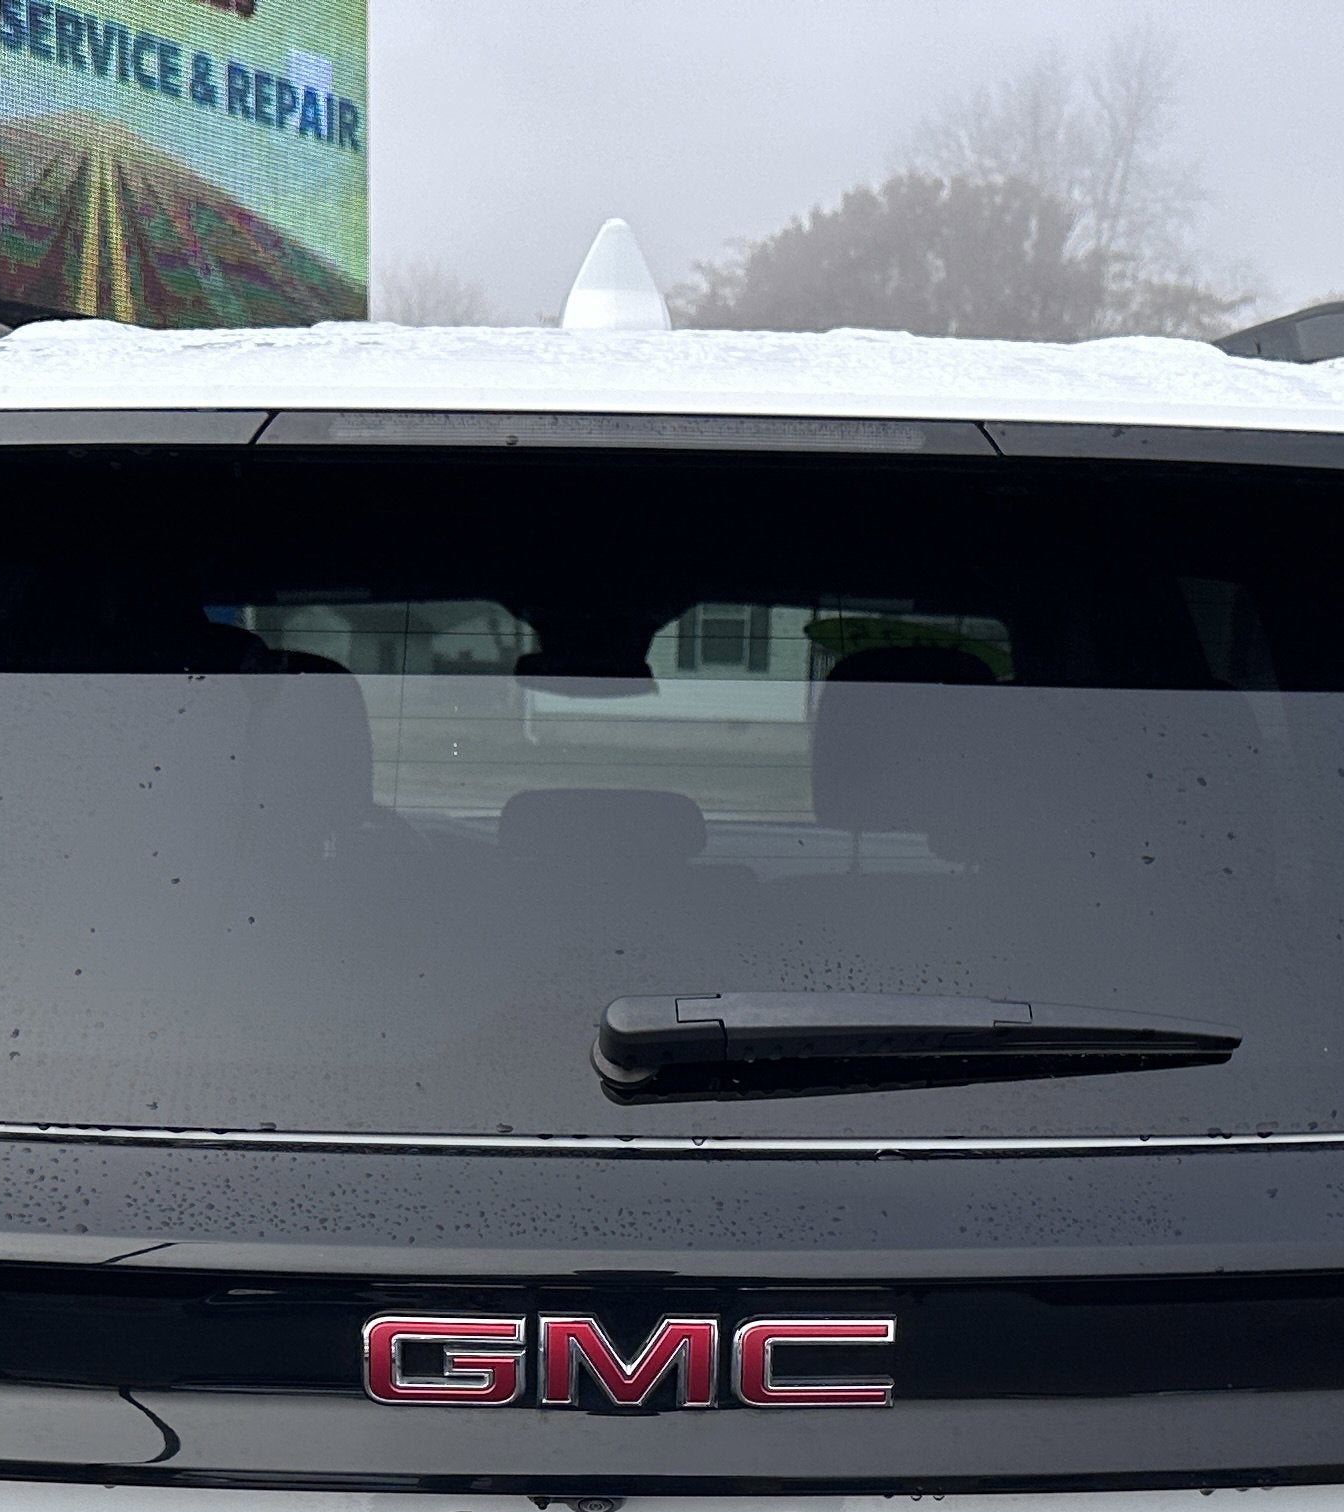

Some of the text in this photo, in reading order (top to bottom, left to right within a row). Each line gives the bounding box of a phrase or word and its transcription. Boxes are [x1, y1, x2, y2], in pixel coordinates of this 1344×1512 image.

[190, 51, 217, 104] &
[227, 59, 358, 150] REPAIR
[362, 1312, 895, 1408] GMC
